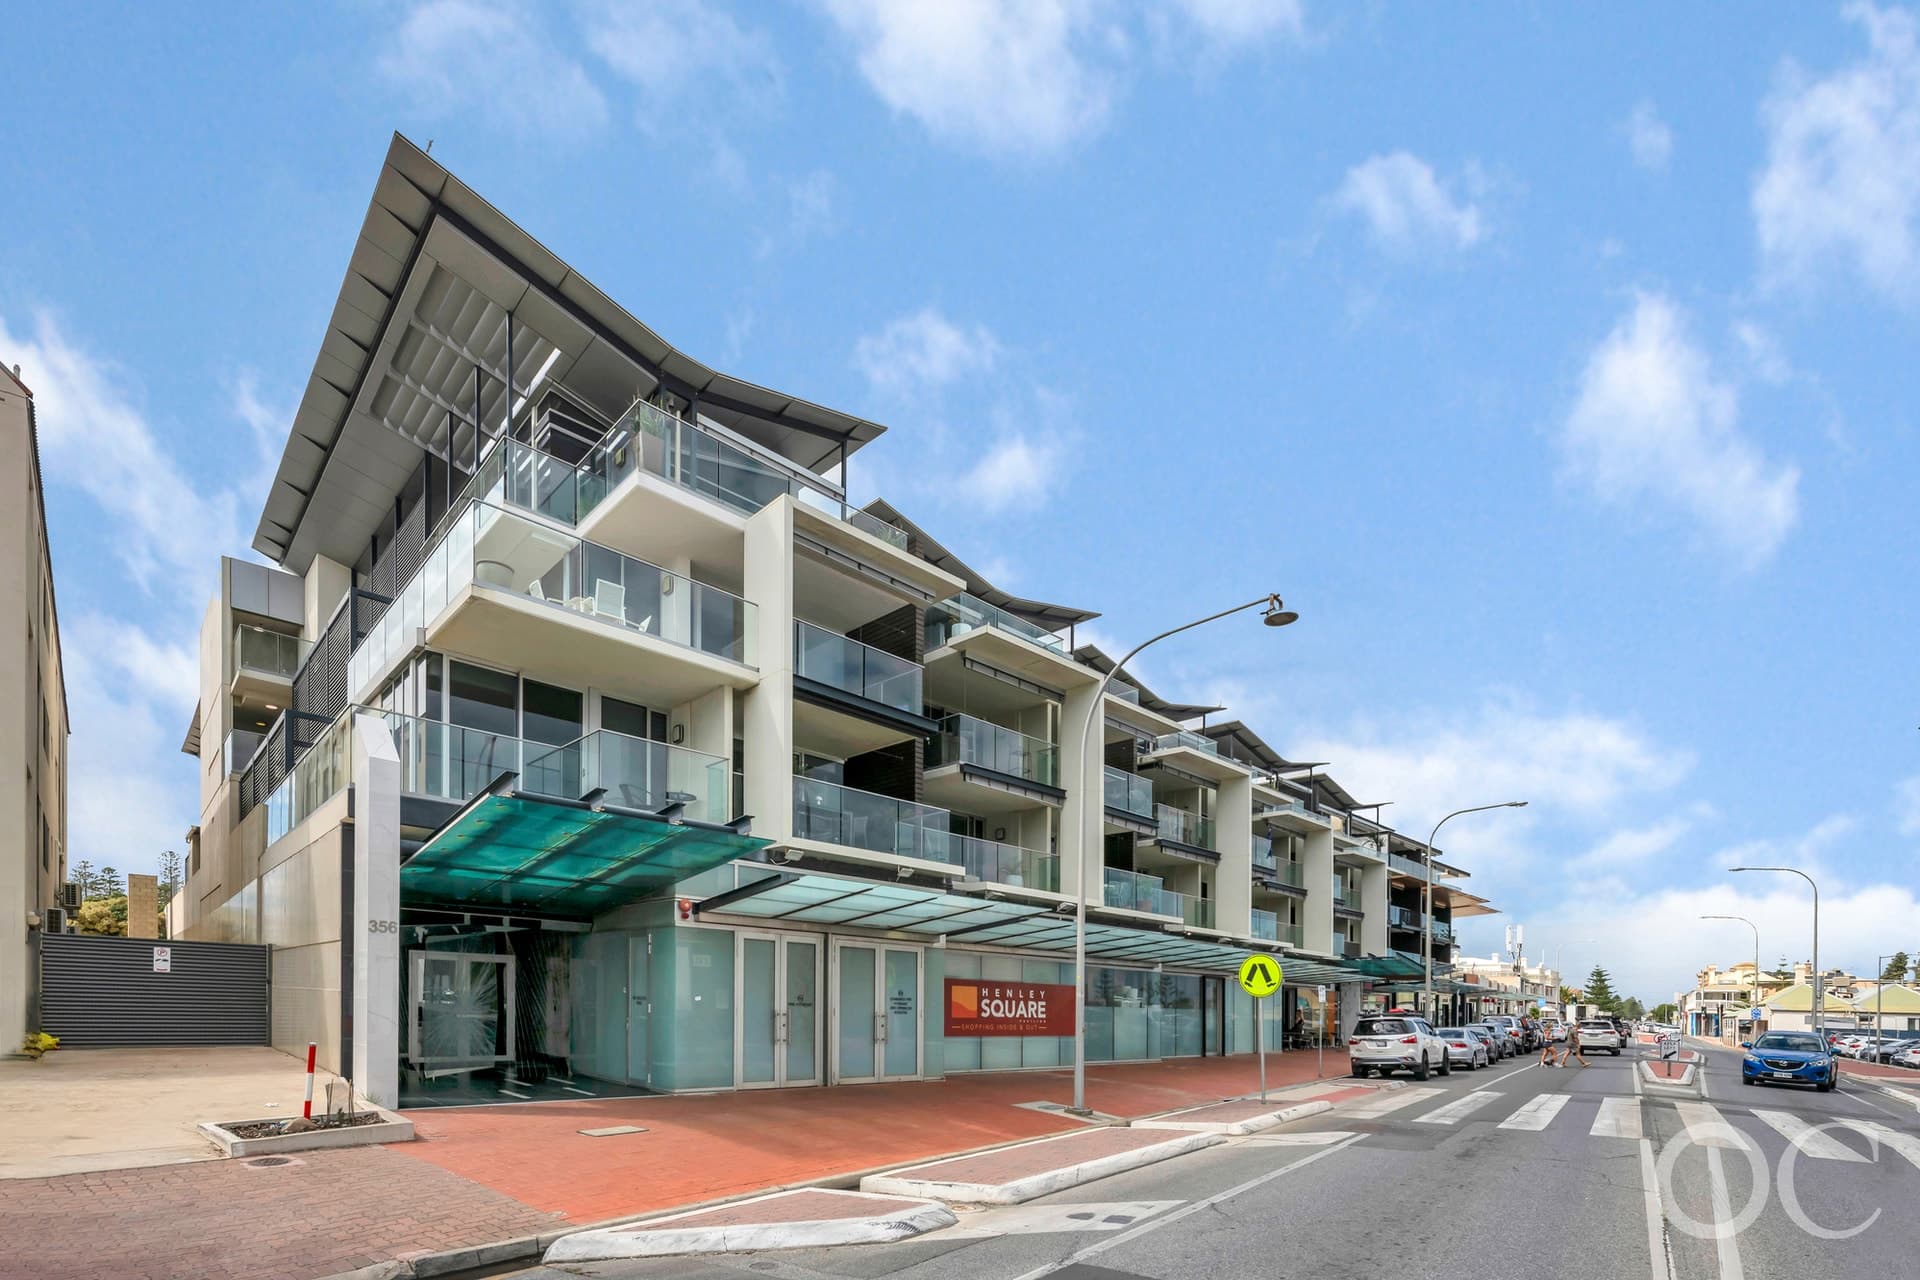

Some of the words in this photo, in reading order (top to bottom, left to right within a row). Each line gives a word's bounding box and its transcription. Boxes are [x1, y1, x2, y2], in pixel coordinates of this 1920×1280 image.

[368, 919, 398, 934] 356
[982, 988, 1046, 999] HENLEY
[981, 999, 1047, 1018] SQUARE
[961, 1023, 994, 1031] SHOPPING
